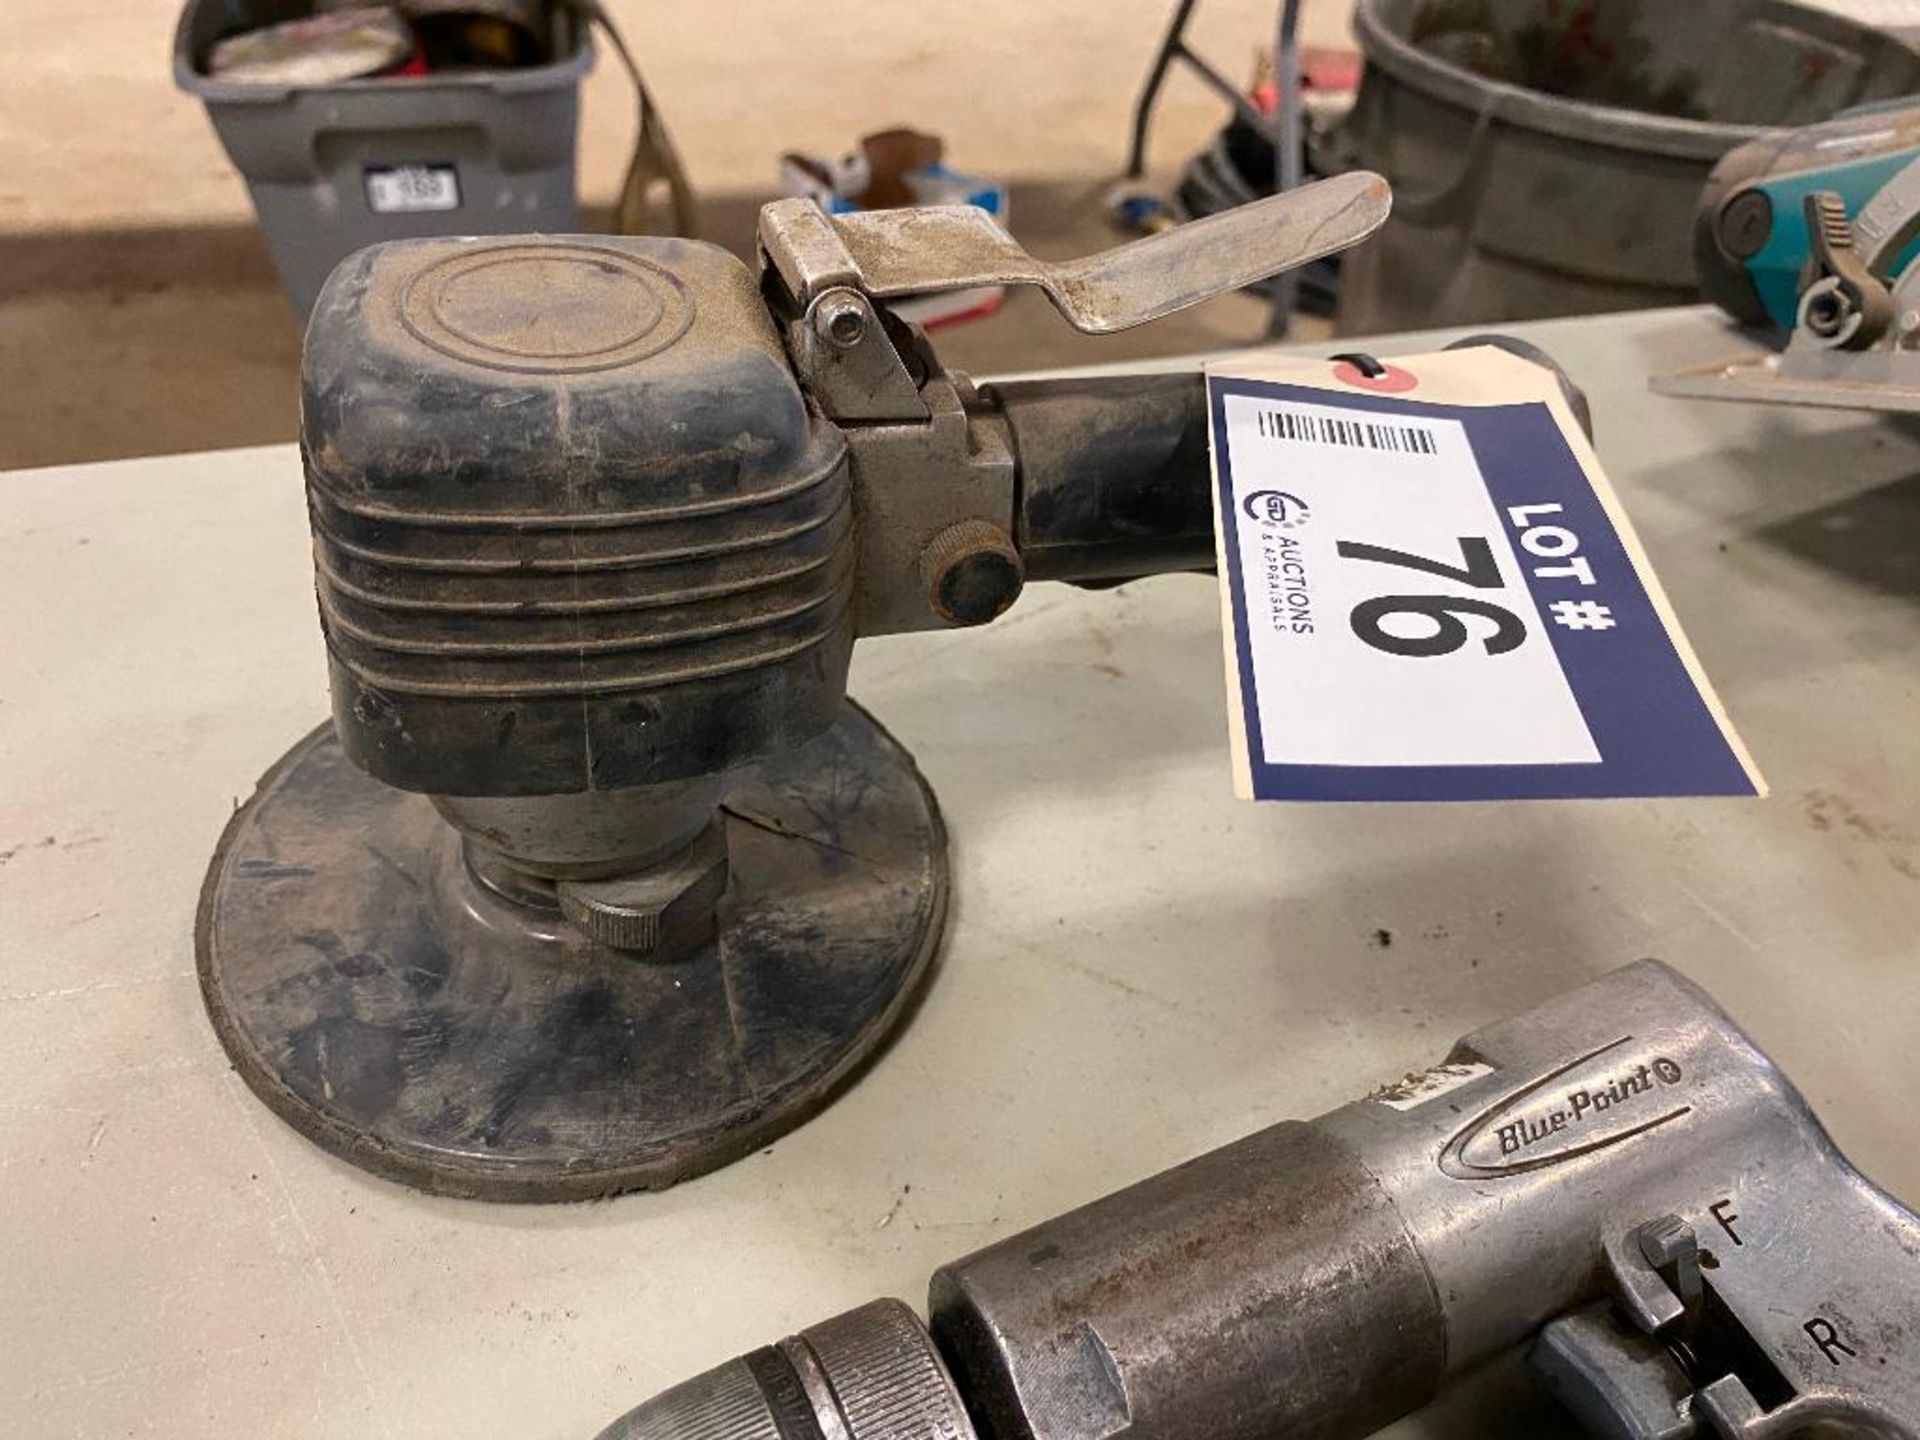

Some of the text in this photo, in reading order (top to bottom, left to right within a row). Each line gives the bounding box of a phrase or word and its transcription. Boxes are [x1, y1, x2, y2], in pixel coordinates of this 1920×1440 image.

[1264, 547, 1288, 632] APPRAISALS
[1278, 536, 1315, 634] AUCTIONS
[1337, 536, 1528, 658] 76
[1506, 502, 1617, 630] LOT #
[1708, 1199, 1743, 1246] F
[1803, 1317, 1857, 1366] R
